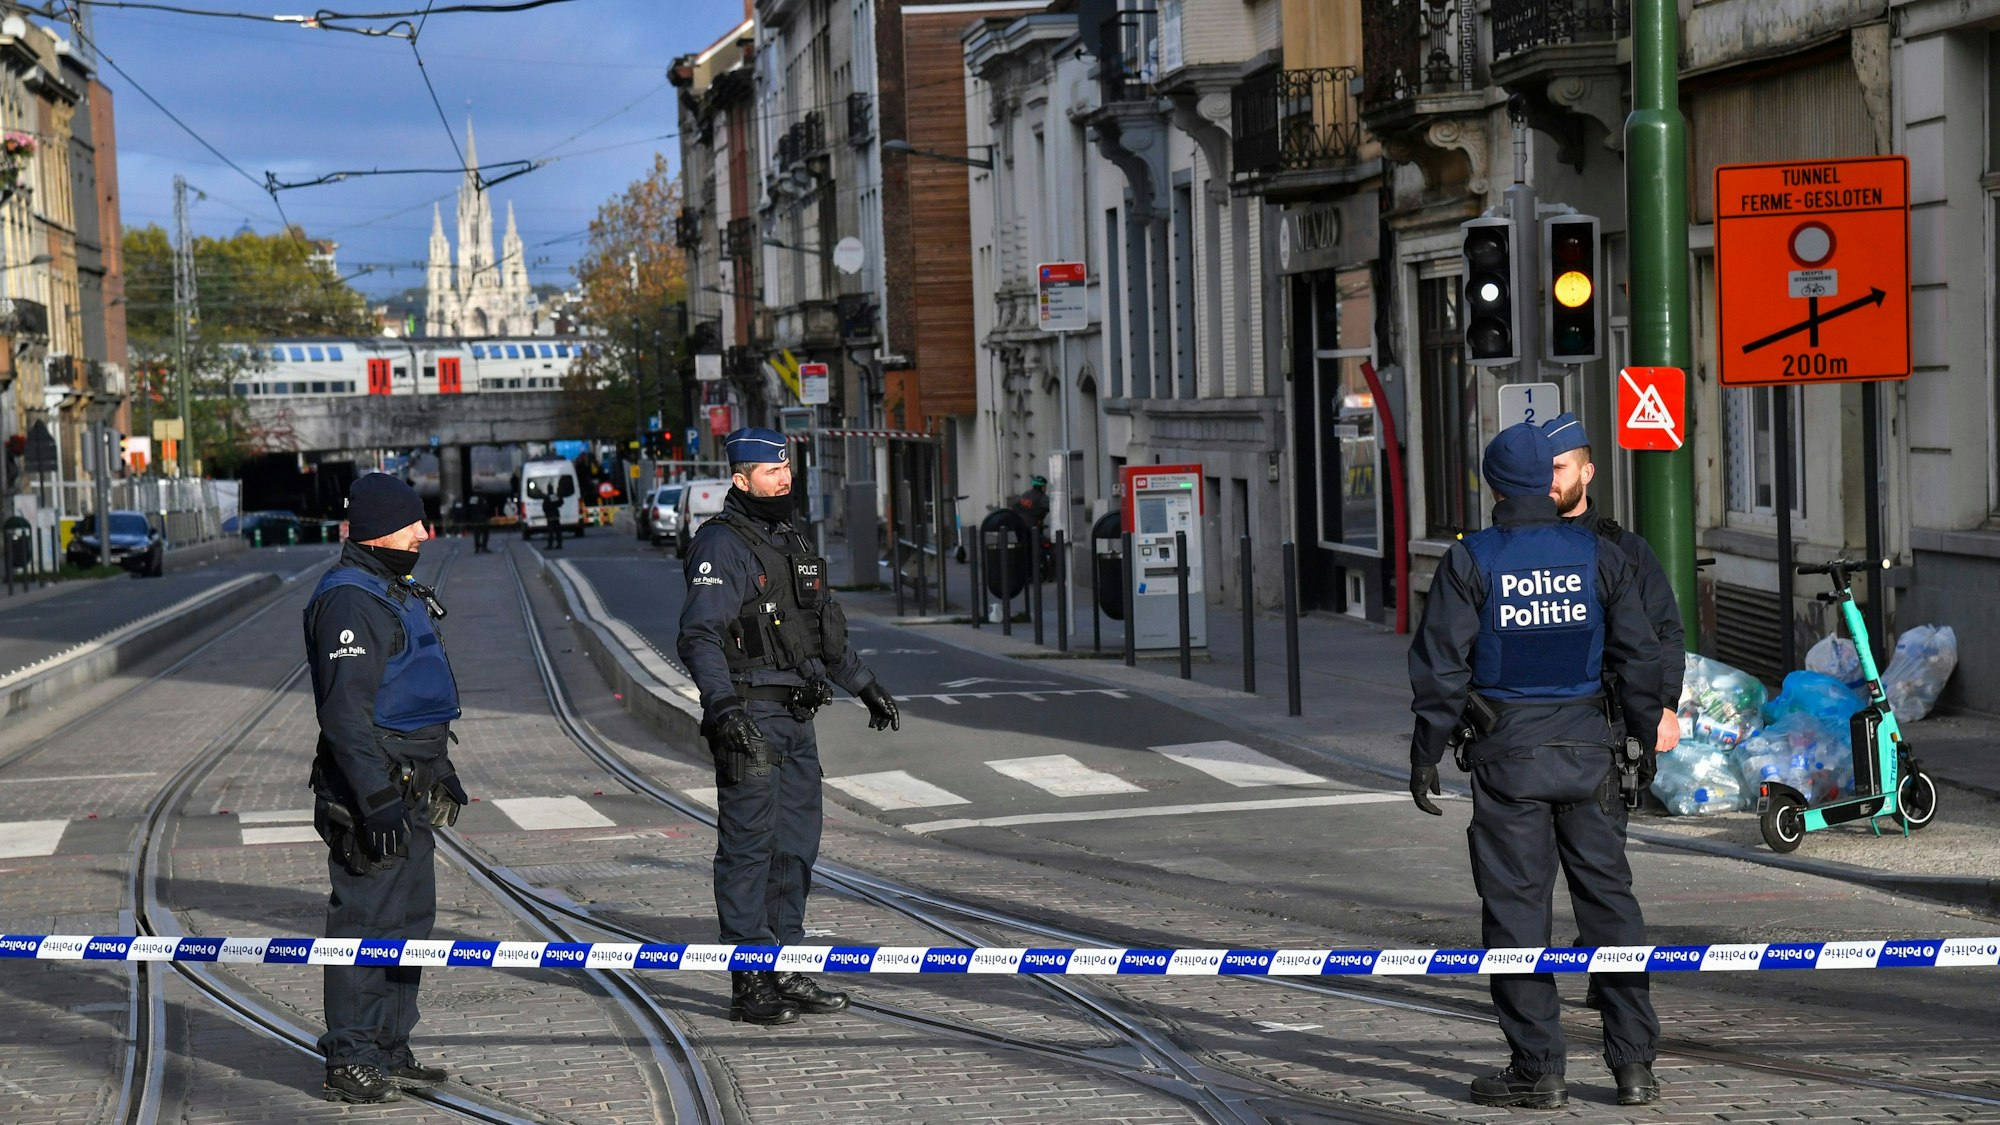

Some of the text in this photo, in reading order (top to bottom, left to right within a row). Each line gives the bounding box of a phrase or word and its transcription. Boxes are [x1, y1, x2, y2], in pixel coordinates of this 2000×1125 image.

[1782, 167, 1841, 186] TUNNEL
[1782, 353, 1848, 376] 200m
[1525, 388, 1532, 403] 1
[1524, 408, 1535, 423] 2
[687, 430, 698, 444] P
[797, 565, 818, 575] POLICE
[702, 576, 723, 584] Politie
[1501, 570, 1581, 598] Police
[1500, 598, 1587, 627] Politie
[349, 646, 366, 654] Polic
[1889, 749, 1898, 784] TIER
[0, 941, 1985, 966] Police Politie Police Politie Police Politie Police Politie Police Politie Police Politie Police Politie Police Politie Police Politie Police Politie Police Politie Police Politie Police Politie Police Politie Police Politie Police Politie Police Politie Police Politie Police Politie Police Politie
